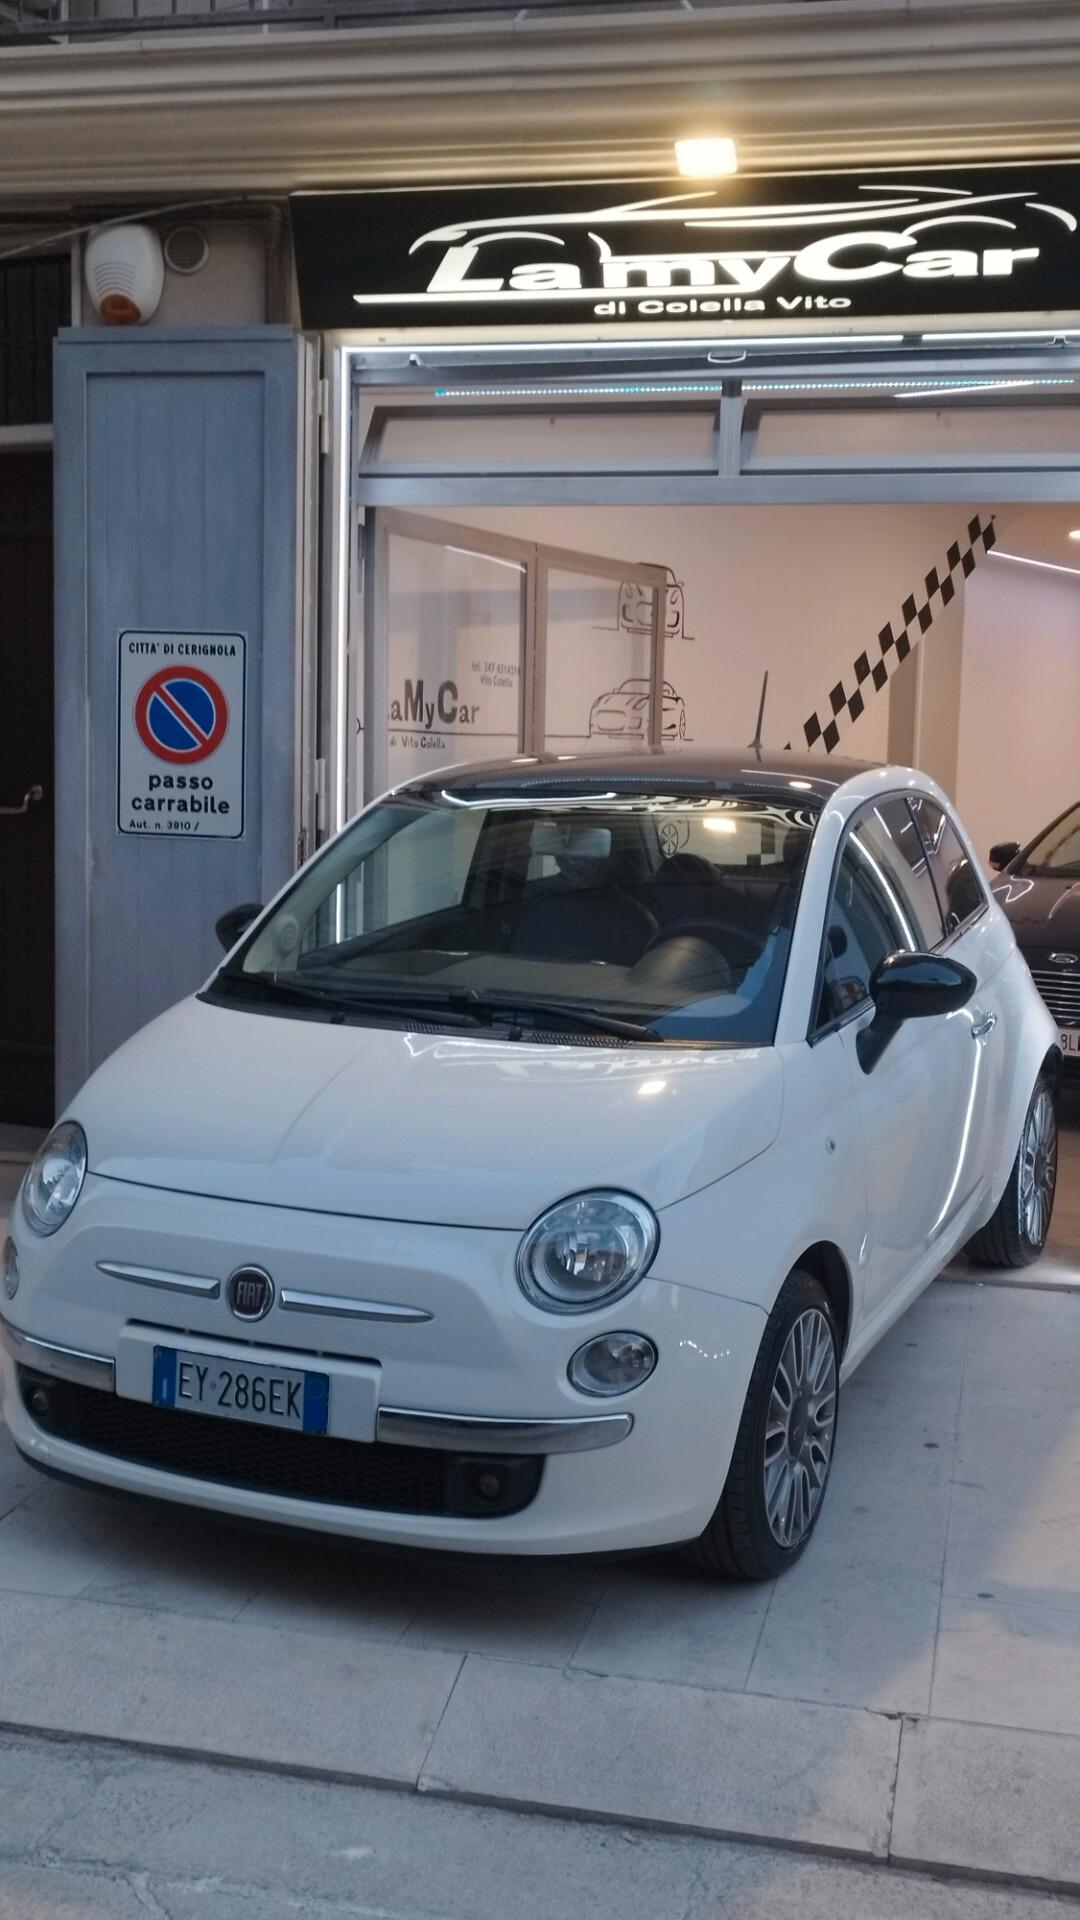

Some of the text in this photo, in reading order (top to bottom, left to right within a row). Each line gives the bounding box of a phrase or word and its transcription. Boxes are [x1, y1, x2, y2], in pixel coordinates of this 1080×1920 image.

[594, 295, 852, 315] di Colella Vito
[163, 643, 175, 655] DI
[177, 644, 237, 657] CERIGNOLA
[387, 679, 480, 730] aMyCar
[148, 774, 214, 791] passo
[131, 795, 230, 814] carrabile
[236, 1280, 265, 1306] FIAT
